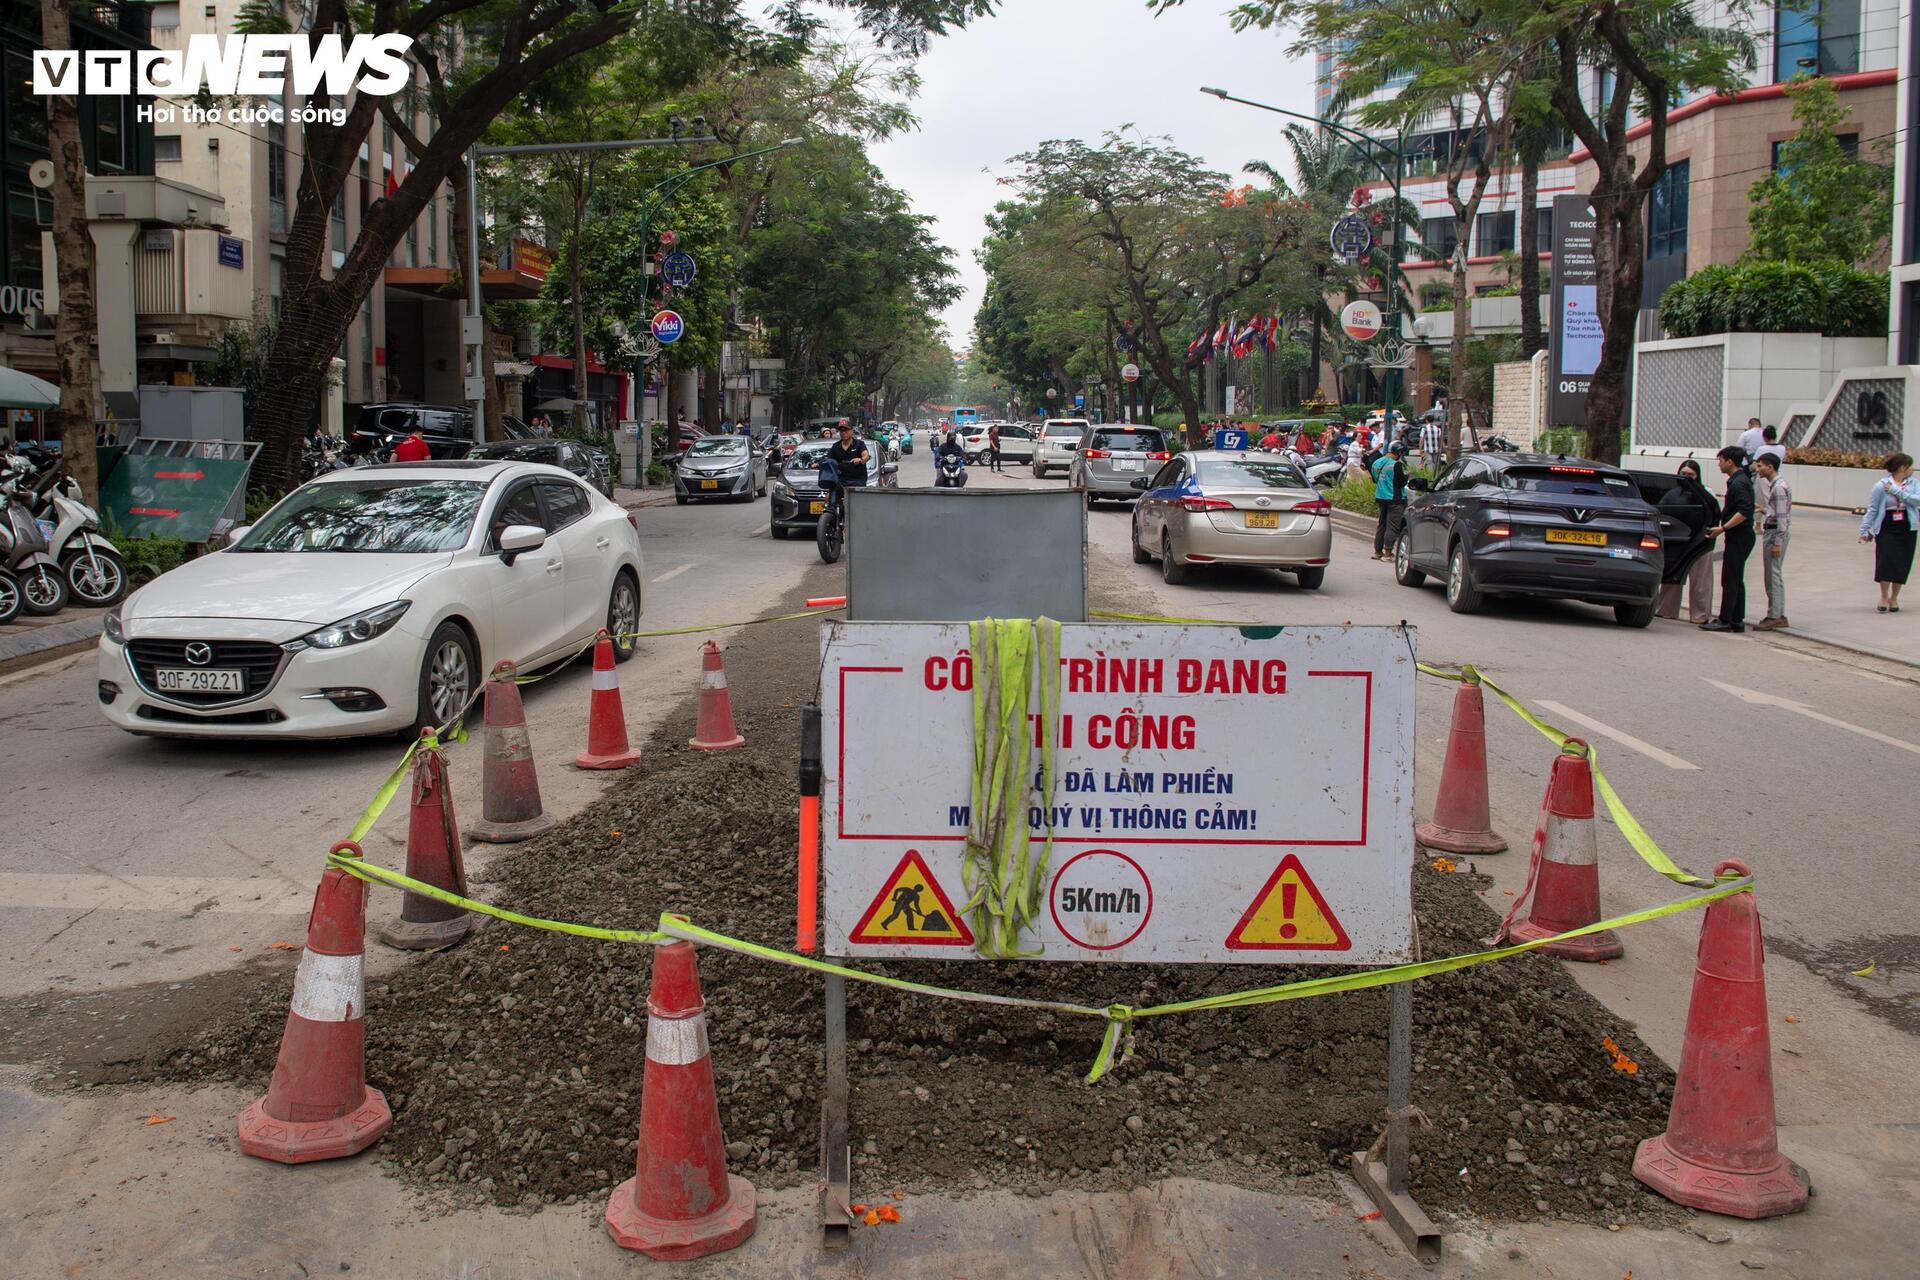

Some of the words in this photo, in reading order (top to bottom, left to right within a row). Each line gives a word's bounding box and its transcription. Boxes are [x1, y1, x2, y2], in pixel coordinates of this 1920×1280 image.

[1570, 221, 1597, 229] TECHCO
[654, 316, 678, 331] Vikki
[1352, 310, 1365, 318] HD
[1352, 317, 1372, 326] Bank
[1560, 381, 1577, 393] 06
[1857, 391, 1888, 427] 06
[1224, 432, 1241, 448] G7
[158, 671, 239, 690] 30F-292.21
[1060, 651, 1164, 693] RÌNH
[1176, 658, 1287, 694] ĐANG
[1087, 707, 1196, 750] CÔNG
[1065, 768, 1097, 793] ĐÃ
[1104, 768, 1154, 793] LÀM
[1162, 766, 1233, 794] PHIỀN
[1080, 807, 1101, 833] VỊ
[1109, 804, 1187, 830] THÔNG
[1194, 802, 1257, 831] CẢM!
[1062, 887, 1141, 914] 5Km/h
